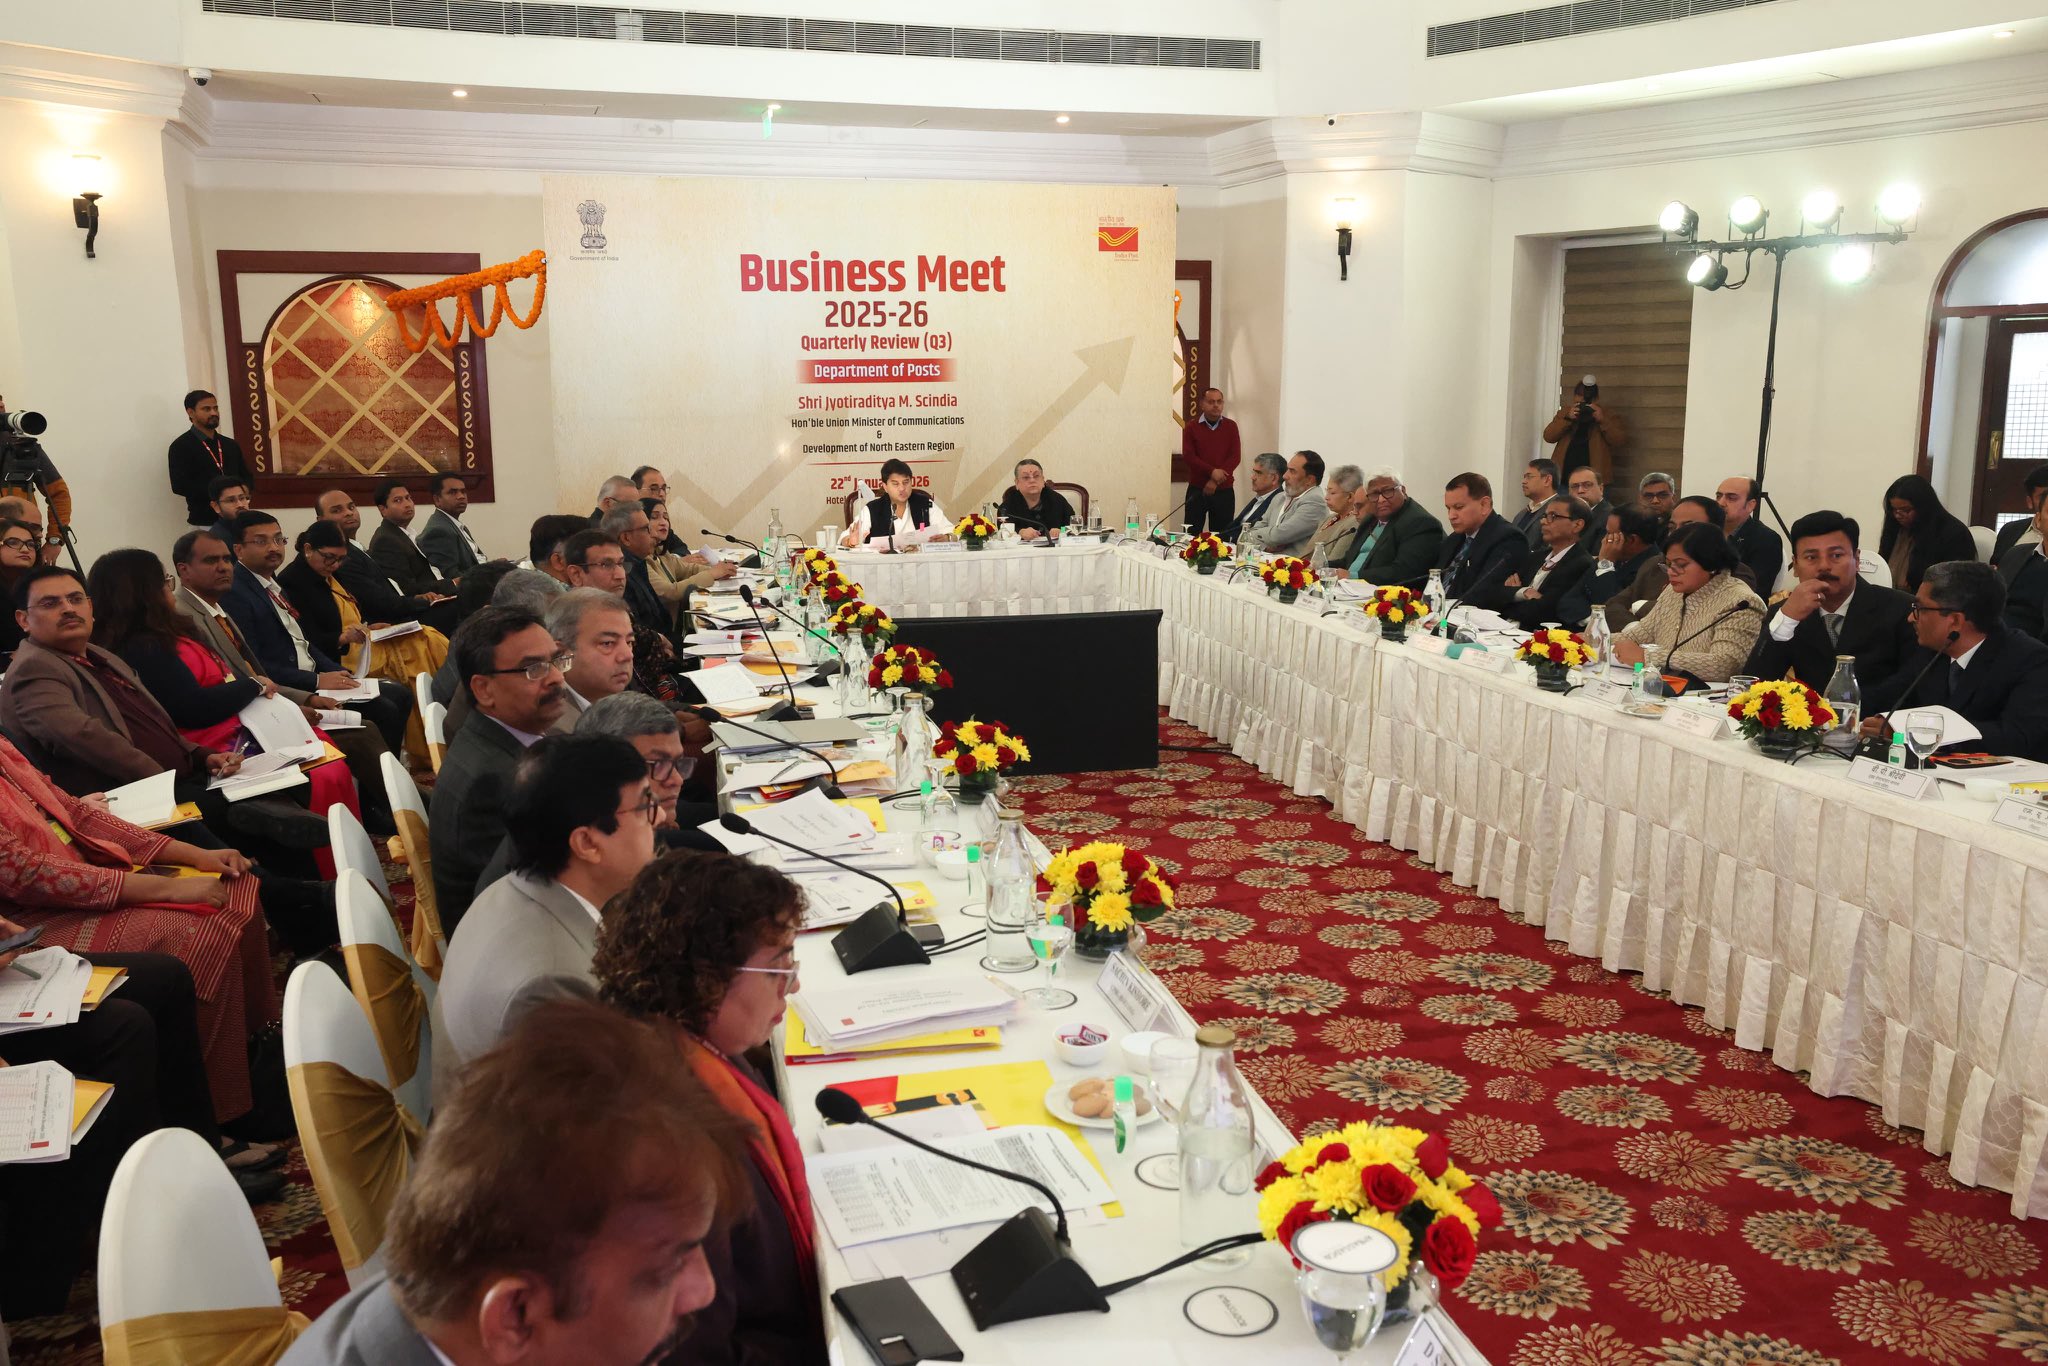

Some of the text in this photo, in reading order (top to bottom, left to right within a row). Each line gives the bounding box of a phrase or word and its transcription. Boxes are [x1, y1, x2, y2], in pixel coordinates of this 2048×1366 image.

[740, 250, 1006, 293] Business Meet
[825, 300, 929, 328] 2025-26
[801, 332, 953, 352] Quarterly Review (Q3)
[814, 363, 941, 380] Department of Posts
[798, 394, 958, 411] Shri Jyotiraditya M. Scindia
[825, 418, 850, 428] Union
[851, 417, 886, 427] Minister
[887, 416, 897, 426] of
[897, 416, 965, 427] Communications
[876, 430, 882, 439] &
[803, 441, 955, 454] Development of North Eastern Region
[854, 476, 884, 491] Jnua
[911, 476, 930, 488] 026
